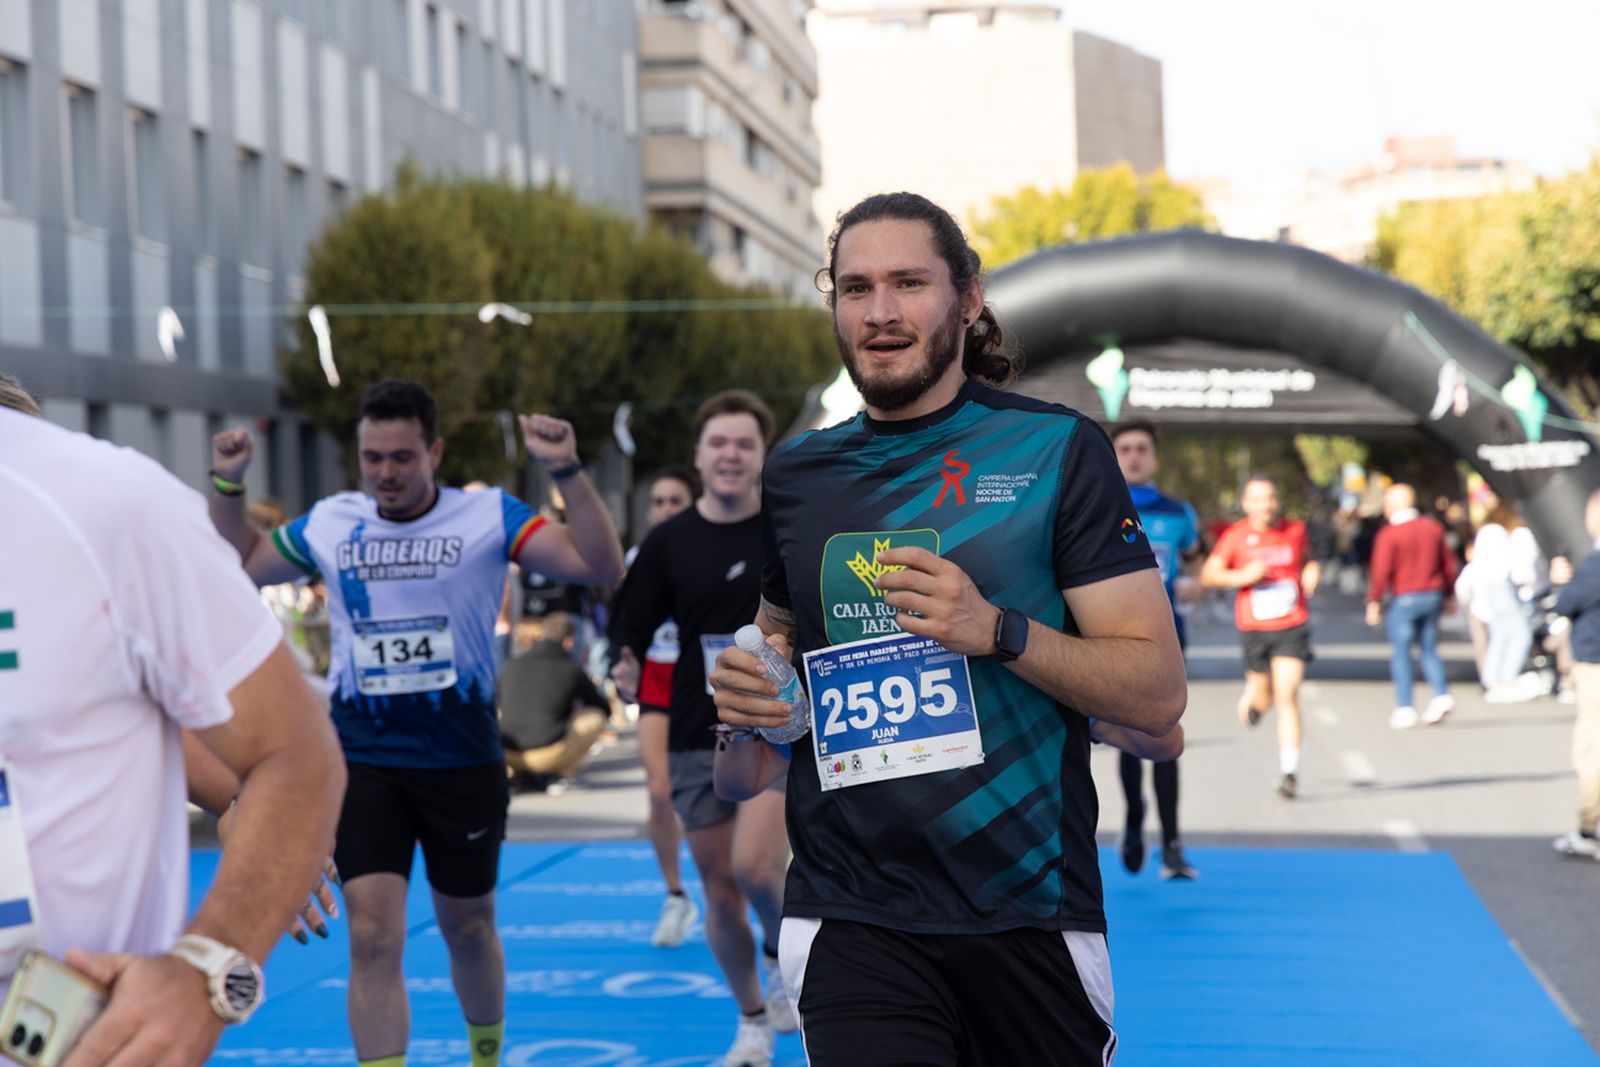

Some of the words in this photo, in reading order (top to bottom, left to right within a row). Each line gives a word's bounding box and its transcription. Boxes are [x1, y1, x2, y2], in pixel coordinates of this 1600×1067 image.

[337, 536, 462, 571] GLOBEROS
[833, 603, 872, 619] CAJA
[862, 616, 902, 634] JAÉN
[372, 637, 433, 664] 134
[852, 650, 870, 660] MEDIA
[866, 655, 890, 665] MEMORIA
[905, 649, 919, 658] PACO
[821, 668, 957, 736] 2595
[872, 726, 899, 740] JUAN
